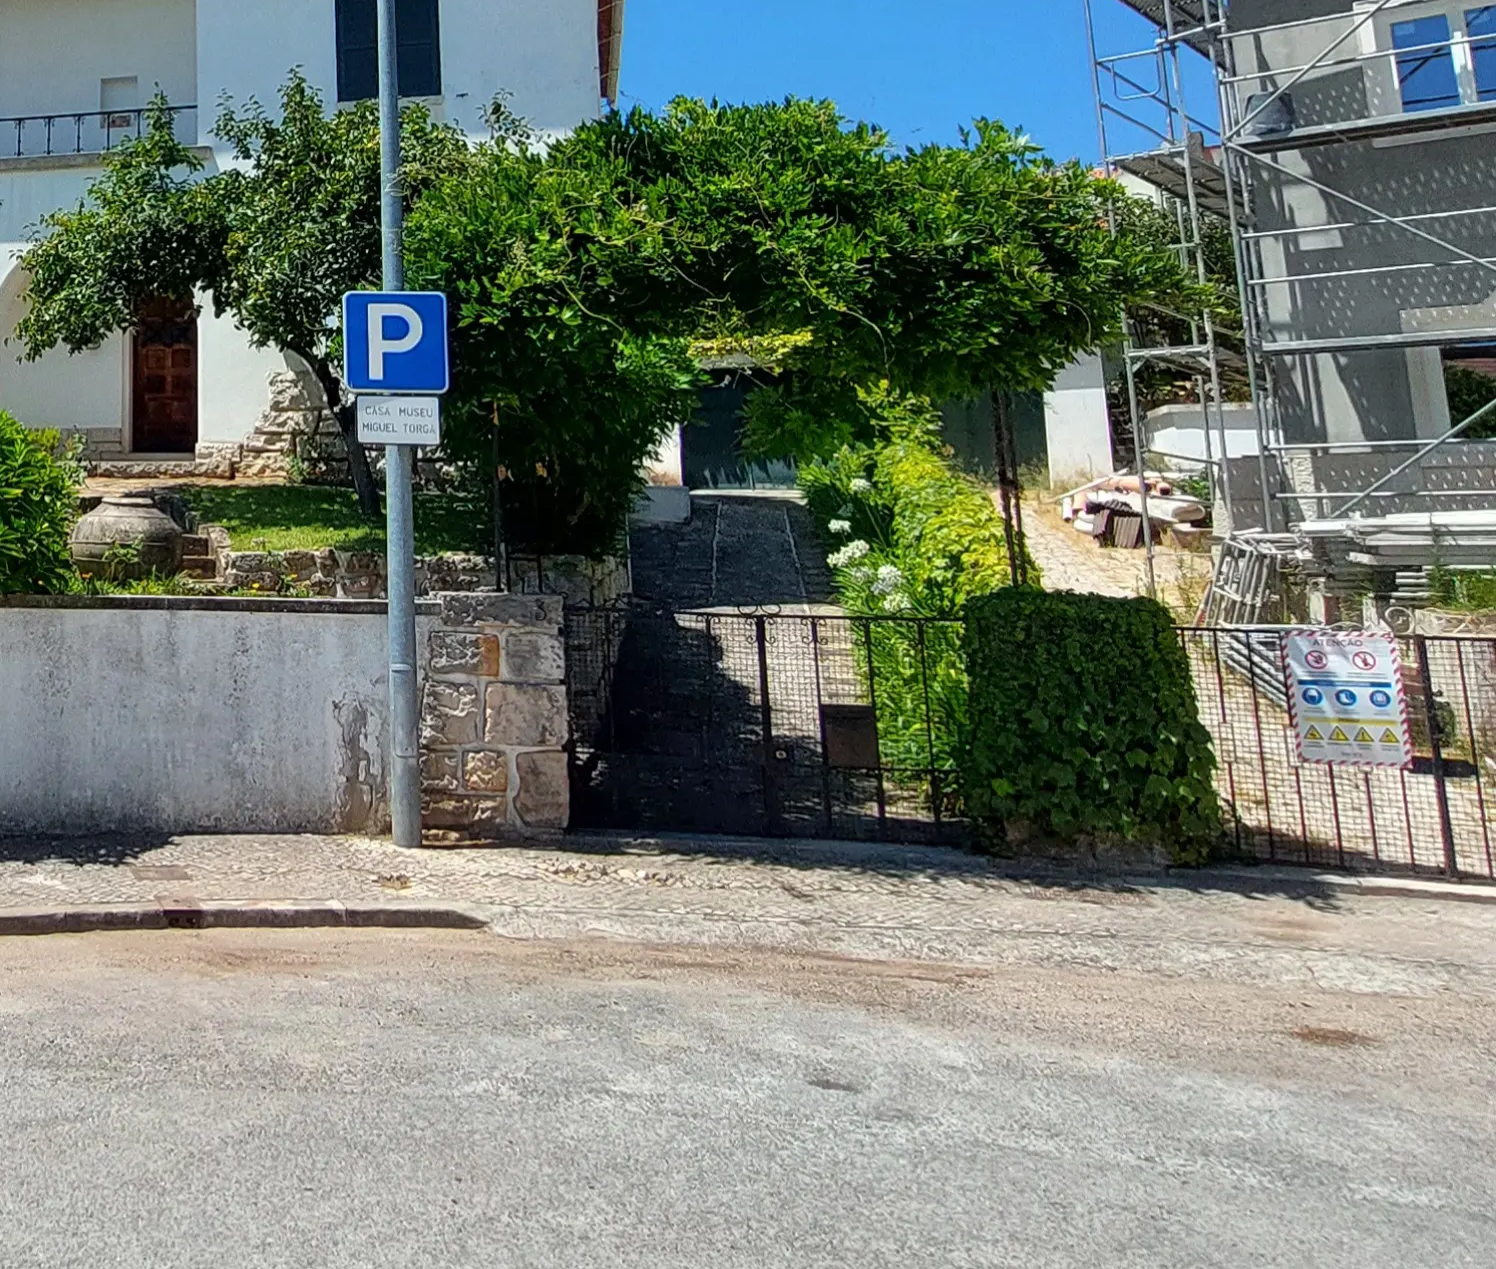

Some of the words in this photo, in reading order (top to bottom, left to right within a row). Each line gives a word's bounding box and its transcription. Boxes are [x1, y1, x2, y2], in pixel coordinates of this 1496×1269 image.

[367, 303, 423, 380] P
[365, 405, 391, 416] CASA
[398, 407, 433, 418] MUSEU
[362, 422, 397, 433] MIGUEL
[403, 423, 436, 434] TORGA
[1313, 637, 1363, 648] ATENÇÃO
